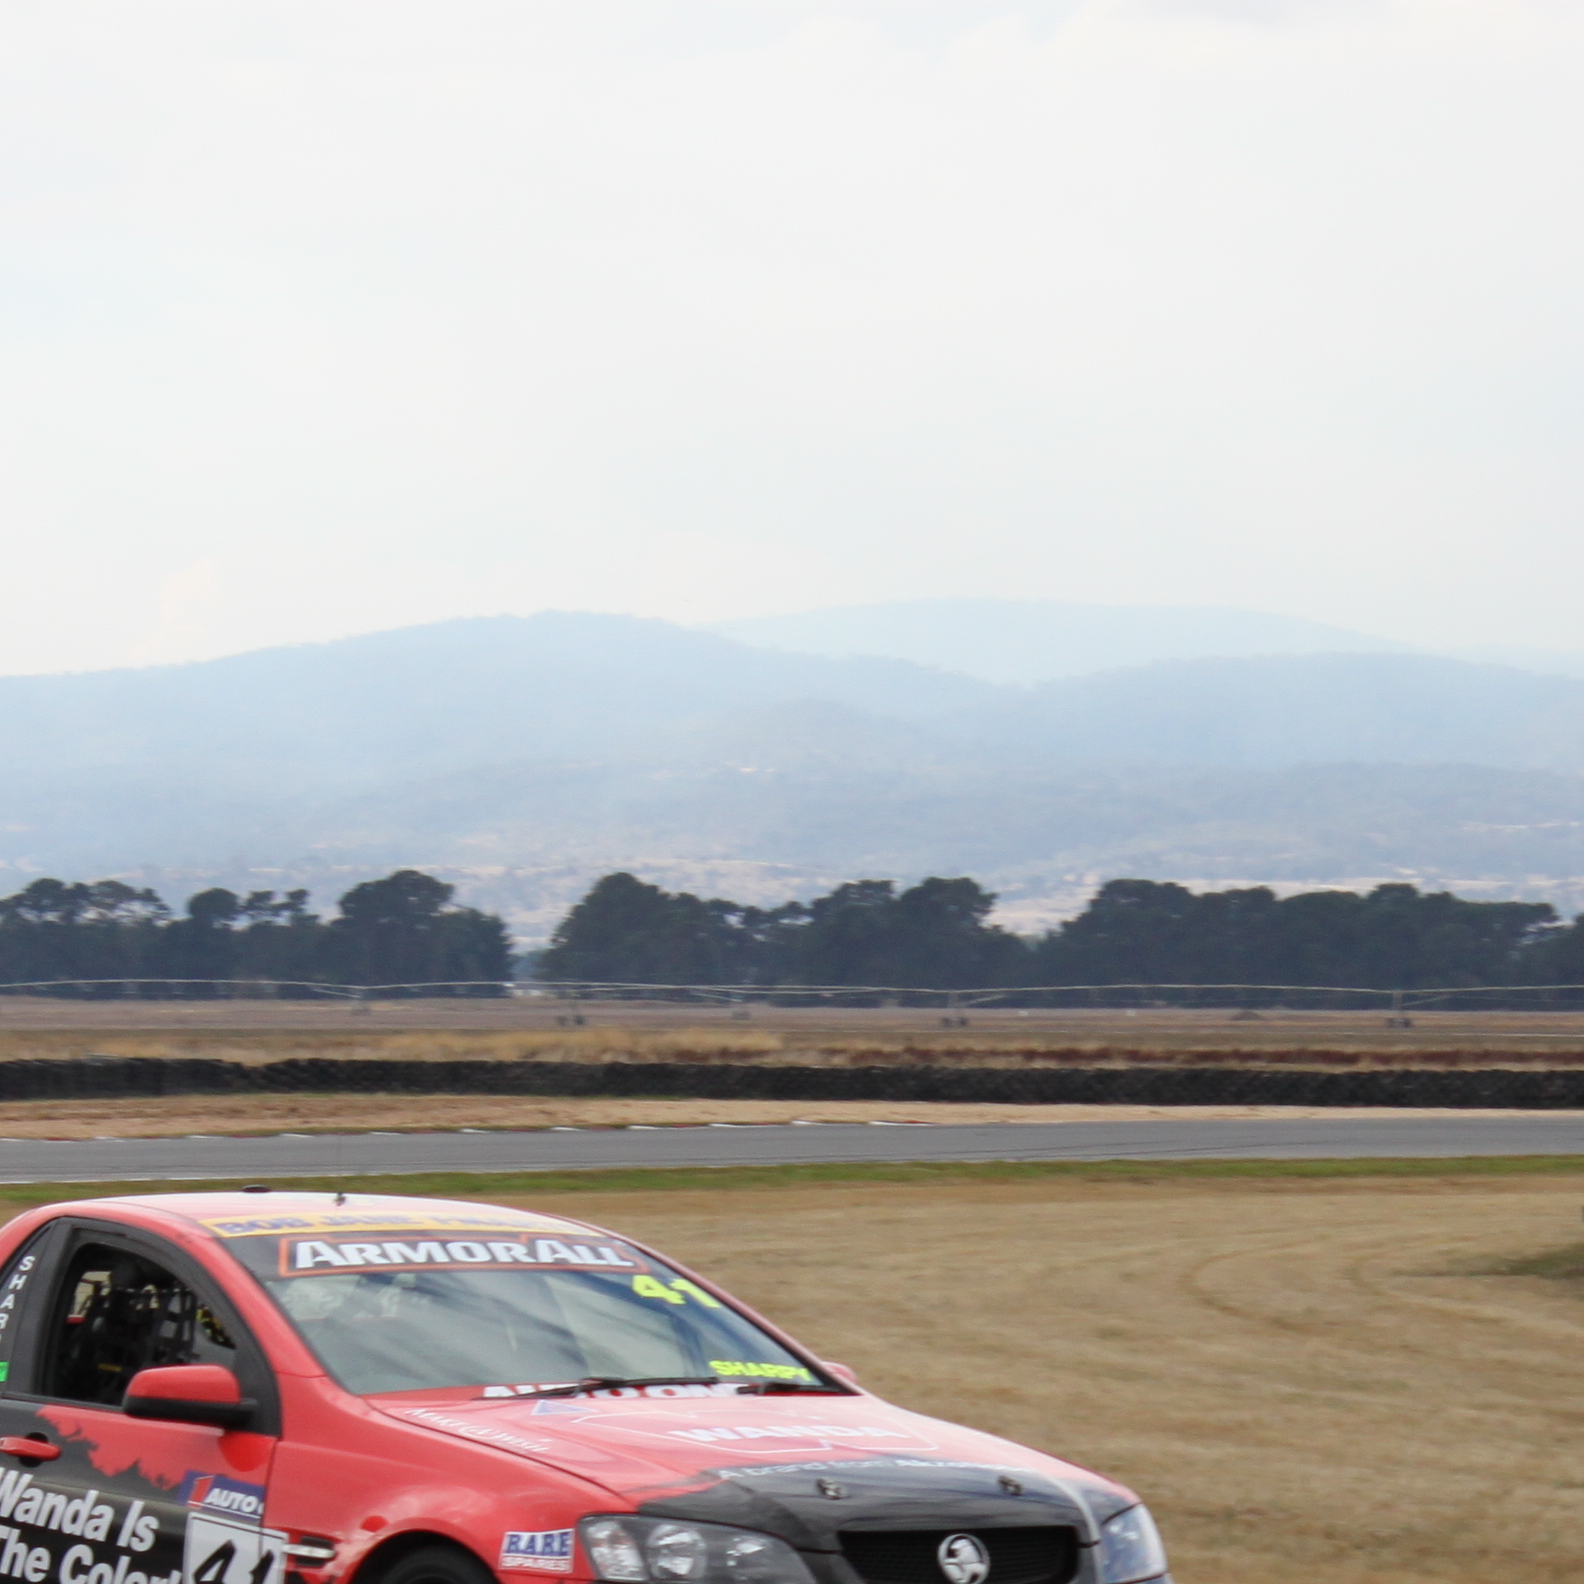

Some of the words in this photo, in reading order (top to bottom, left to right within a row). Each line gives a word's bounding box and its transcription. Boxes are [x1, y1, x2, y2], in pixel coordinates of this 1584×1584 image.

[632, 1274, 721, 1308] 41
[116, 1500, 160, 1552] Is
[506, 1531, 572, 1557] RARE
